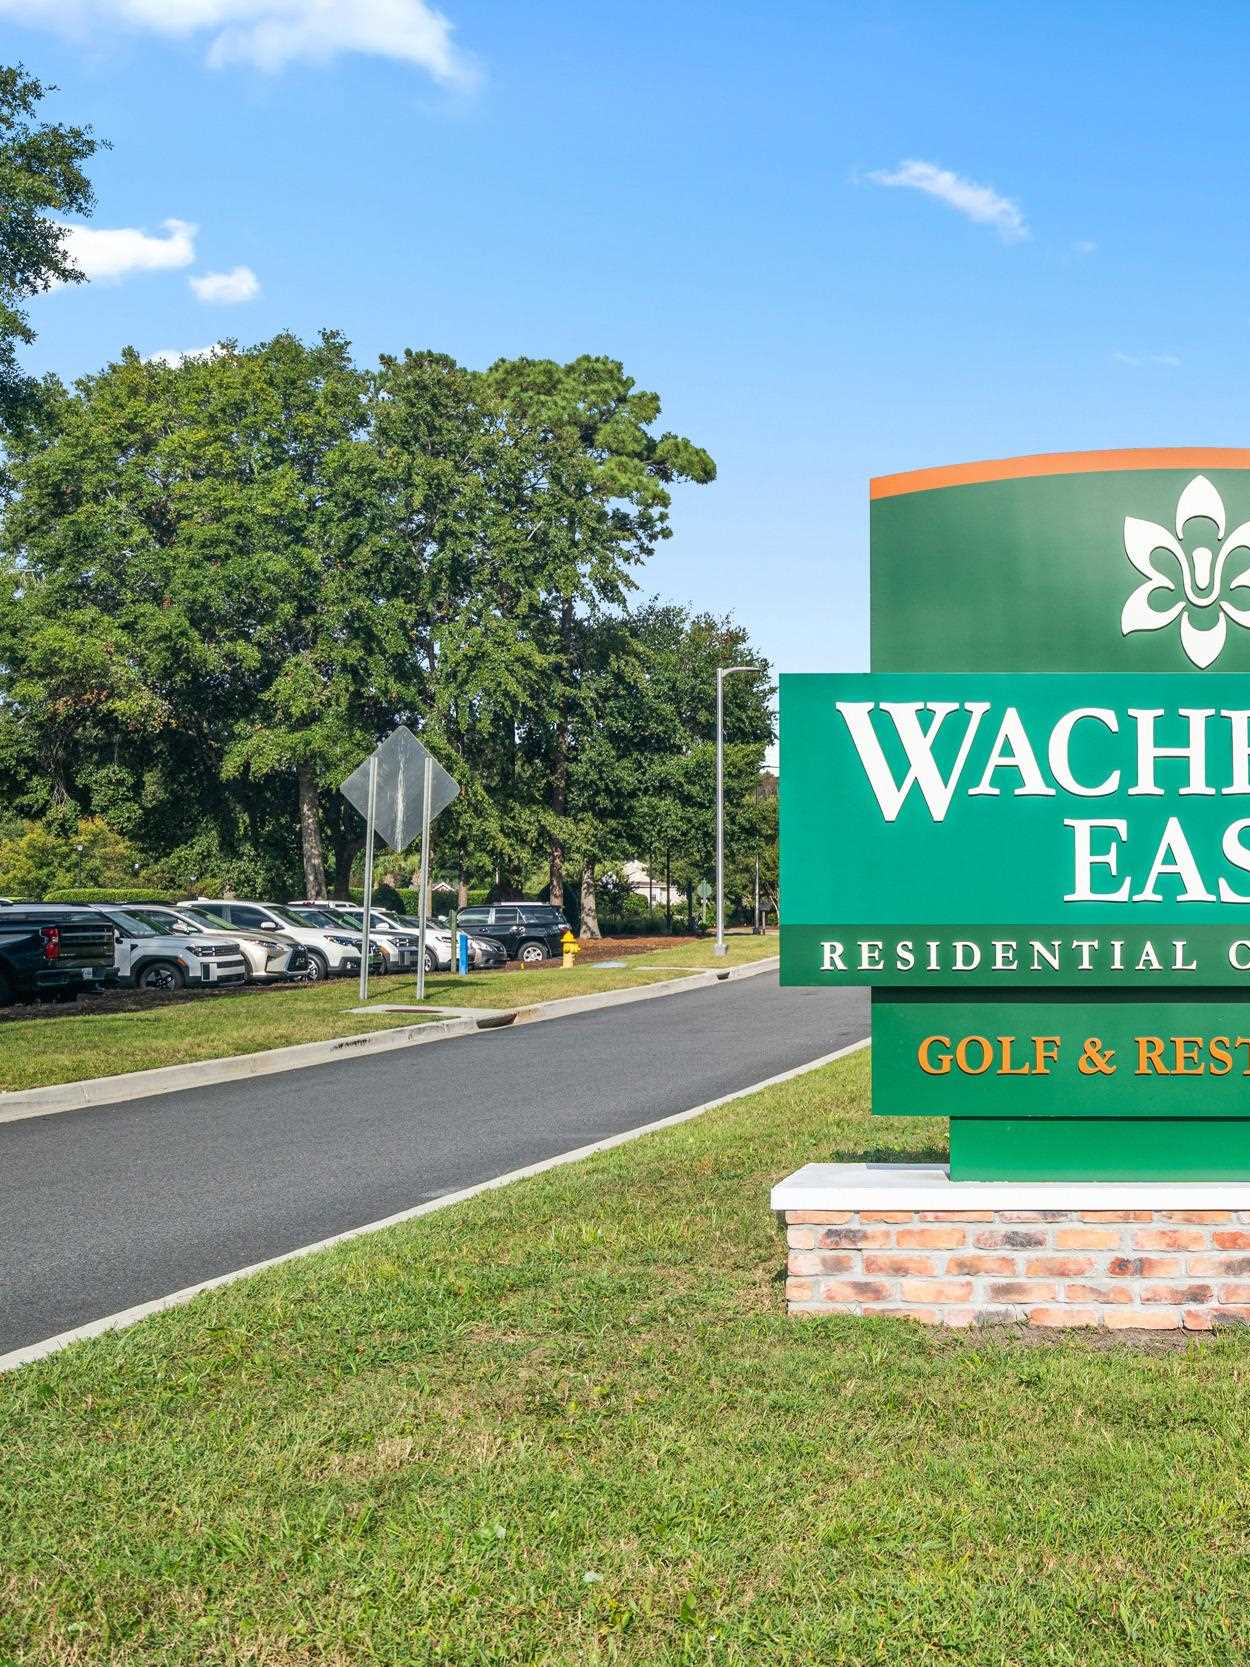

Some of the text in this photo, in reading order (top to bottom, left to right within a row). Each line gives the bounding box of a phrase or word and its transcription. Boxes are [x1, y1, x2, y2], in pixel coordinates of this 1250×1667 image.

[820, 940, 1198, 972] RESIDENTIAL
[917, 1035, 1061, 1076] GOLF
[1078, 1039, 1116, 1075] &
